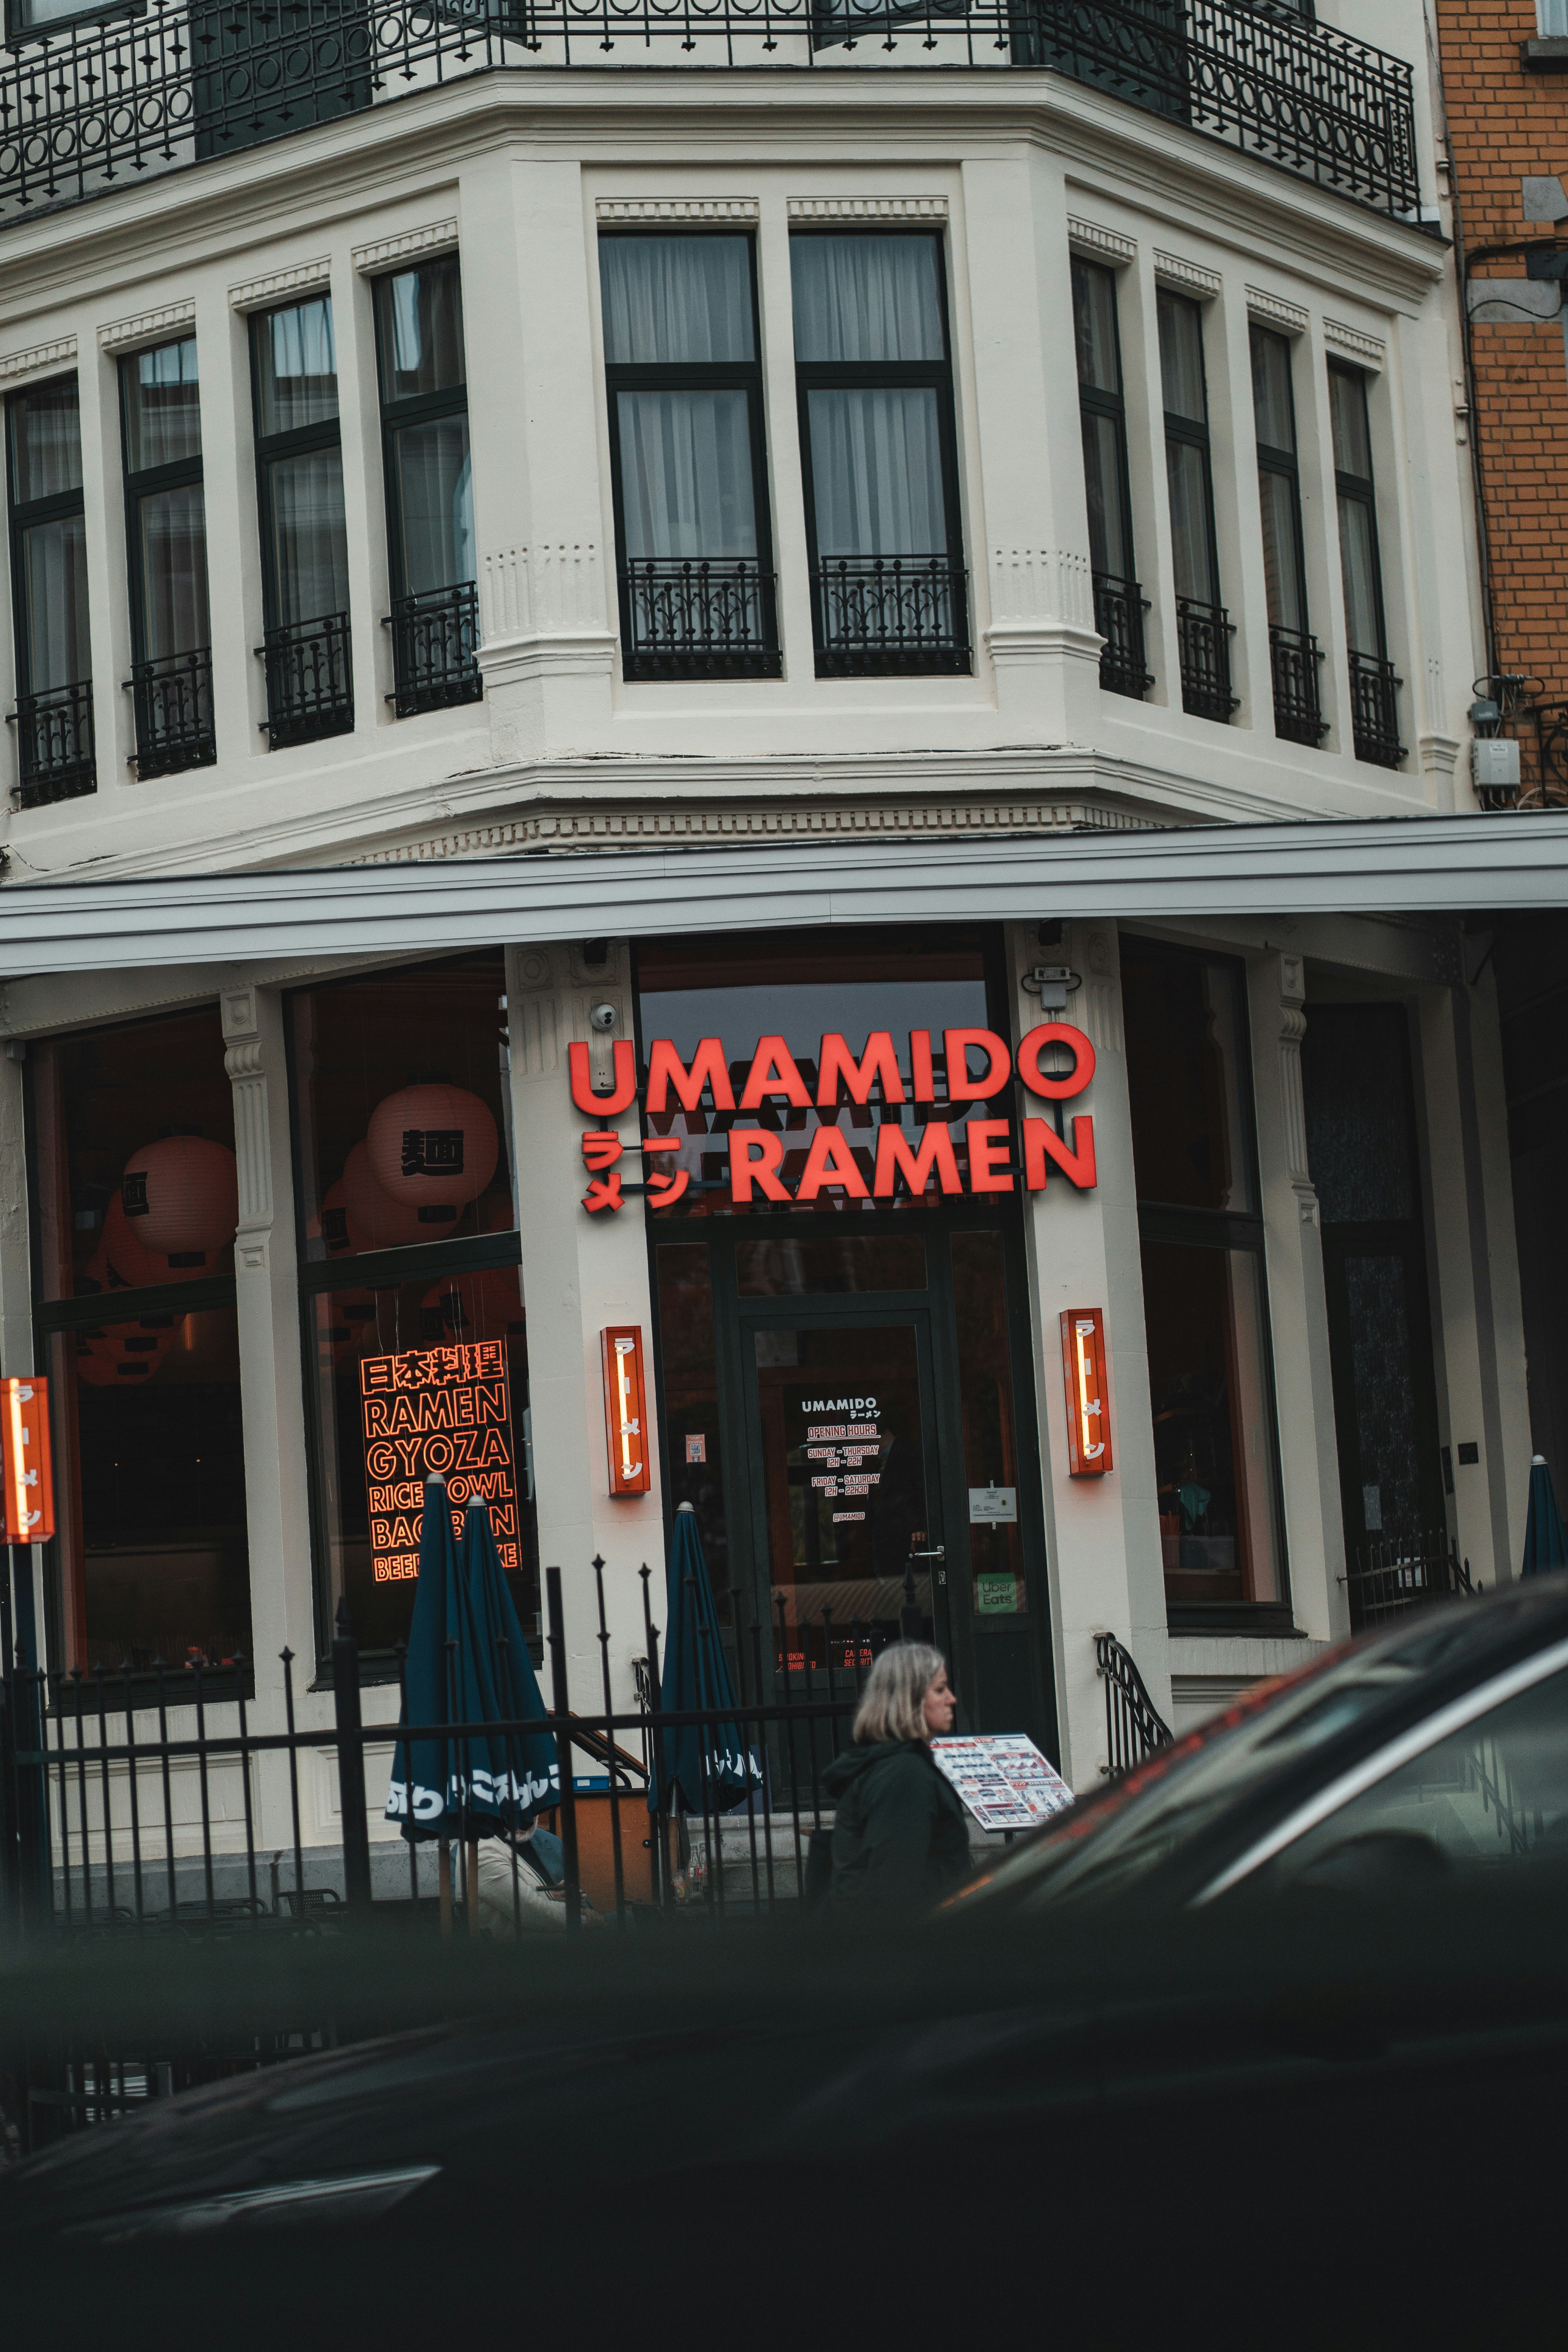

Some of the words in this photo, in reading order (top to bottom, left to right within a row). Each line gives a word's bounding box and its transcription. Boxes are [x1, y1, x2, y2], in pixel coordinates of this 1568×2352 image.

[568, 1022, 1096, 1116] UMAMIDO
[728, 1115, 1097, 1202] RAMEN
[361, 1340, 504, 1395] 日本料理
[1075, 1319, 1105, 1460] ラーメン
[364, 1383, 506, 1438] RAMEN
[615, 1338, 642, 1480] ラーメン
[802, 1397, 876, 1412] UMAMIDO
[850, 1410, 881, 1419] ラーメン
[808, 1425, 846, 1438] OPENING
[848, 1424, 877, 1436] HOURS
[367, 1428, 510, 1480] GYOZA
[808, 1447, 836, 1458] SUNDAY
[843, 1445, 879, 1456] THURSDAY
[827, 1457, 840, 1467] 12H
[847, 1456, 862, 1466] 22H
[811, 1476, 837, 1487] FRIDAY
[844, 1474, 880, 1485] SATURDAY
[369, 1481, 424, 1513] RICE
[445, 1472, 513, 1504] OWL
[825, 1486, 837, 1497] 12H
[845, 1485, 868, 1495] 22H30
[833, 1512, 865, 1522] @UMAMIDO
[982, 1582, 1011, 1592] Uber
[983, 1594, 1012, 1604] Eats
[779, 1653, 805, 1661] SOKIN
[846, 1649, 871, 1657] CAERA
